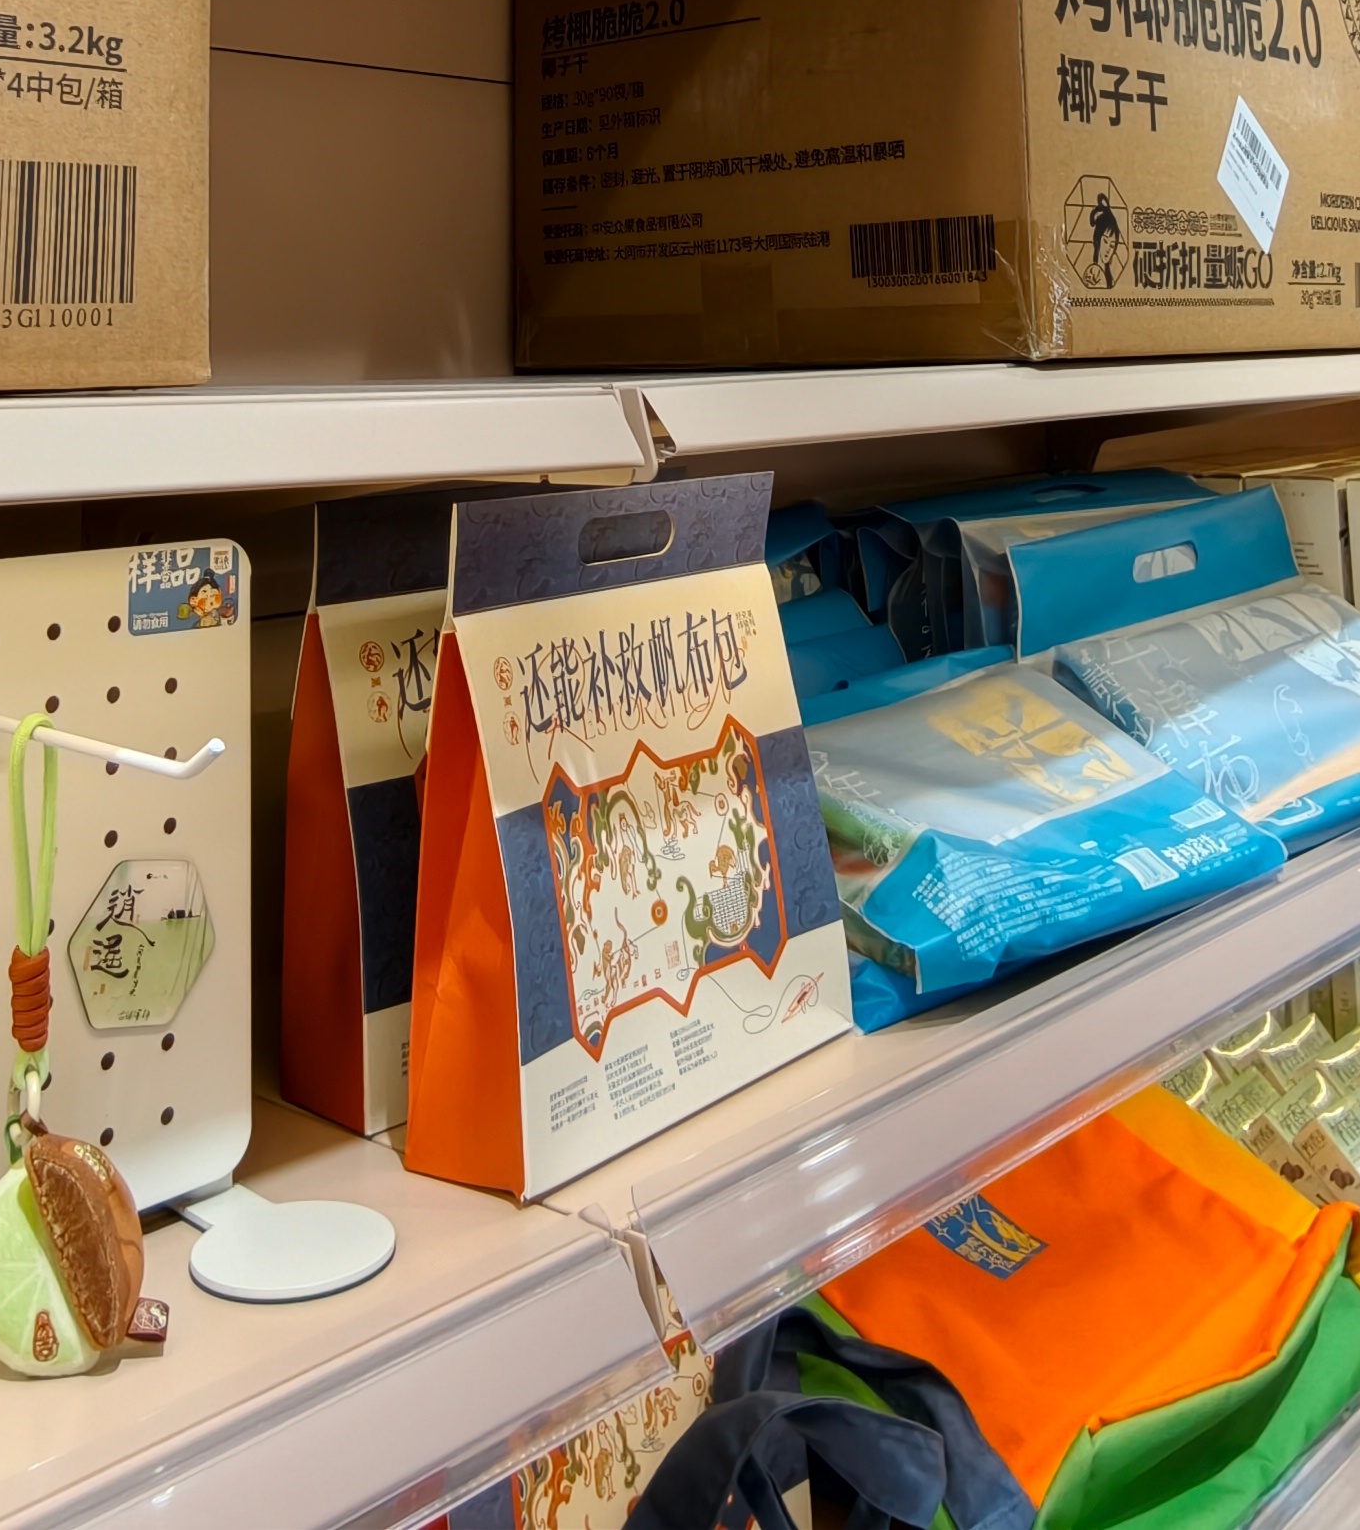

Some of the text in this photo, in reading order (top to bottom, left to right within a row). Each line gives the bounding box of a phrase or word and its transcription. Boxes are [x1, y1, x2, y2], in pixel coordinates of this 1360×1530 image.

[1056, 53, 1169, 132] 椰子干
[1310, 214, 1348, 233] DELICIOUS
[129, 547, 201, 594] 样品
[516, 608, 748, 744] 还能补救帆布包
